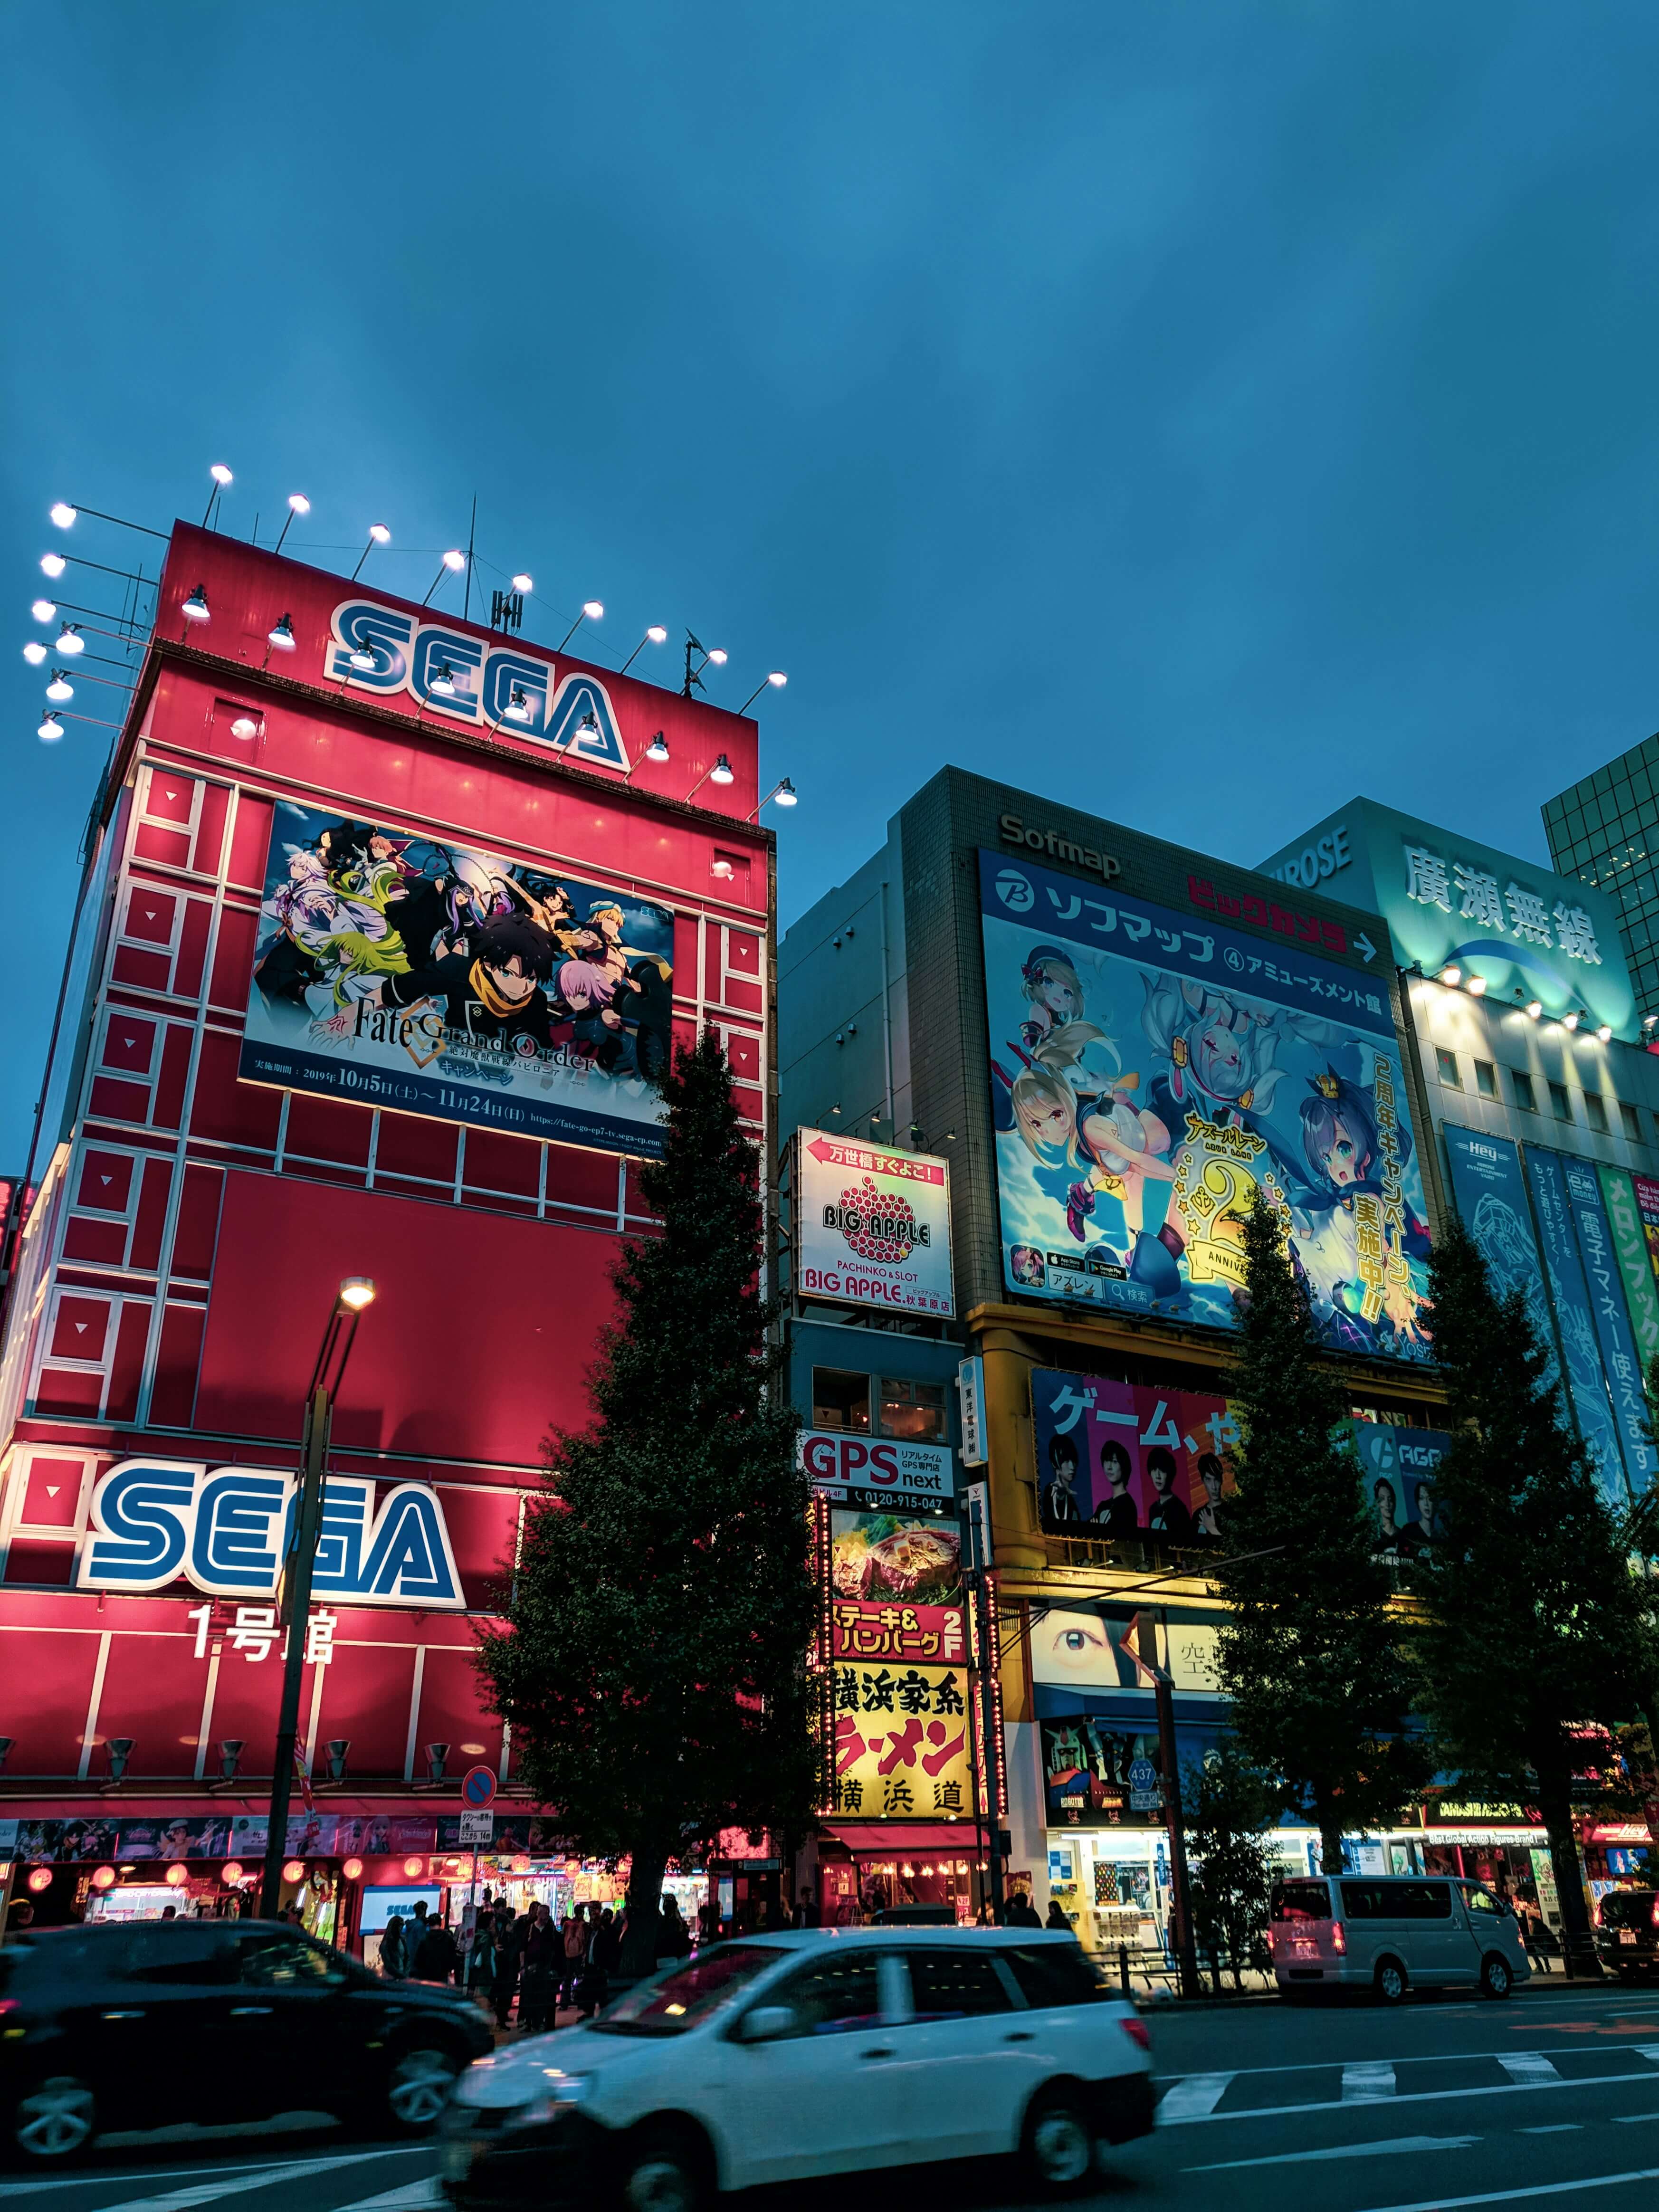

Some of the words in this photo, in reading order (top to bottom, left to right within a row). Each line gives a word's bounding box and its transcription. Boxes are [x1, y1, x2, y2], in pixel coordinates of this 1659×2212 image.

[324, 600, 631, 773] SEGA
[1001, 814, 1121, 880] Sofmap
[1046, 887, 1215, 962] ソフマップ
[1187, 875, 1347, 953] ビックカメラ
[352, 996, 413, 1048] Fate
[415, 1013, 511, 1051] Grand
[510, 1031, 596, 1072] Order
[440, 1059, 514, 1086] キャンペーン
[448, 1045, 560, 1077] 絶対魔獣戦線バビロニア
[1186, 1112, 1265, 1152] アズールレーン
[1205, 1143, 1227, 1154] AZUR
[1230, 1149, 1252, 1160] LANE
[1469, 1141, 1497, 1162] Hey
[1467, 1164, 1507, 1179] ENTERTAINMENT
[1573, 1188, 1597, 1204] money
[823, 1203, 862, 1232] BIG
[869, 1214, 931, 1247] APPLE
[1643, 1212, 1659, 1224] 日本
[837, 1260, 887, 1278] PACHINKO
[895, 1270, 918, 1283] SLOT
[1099, 1265, 1113, 1273] Google
[1609, 1178, 1659, 1358] メロンブック
[805, 1268, 841, 1292] BIG
[1052, 1273, 1095, 1290] アズレン
[906, 1295, 950, 1312] 秋葉原店
[1127, 1288, 1148, 1304] 検索
[1581, 1211, 1650, 1471] 電子マネー使えます
[803, 1436, 898, 1486] GPS
[902, 1450, 942, 1463] リアルタイム
[902, 1460, 940, 1472] GPS専門店
[903, 1474, 942, 1490] next
[865, 1491, 943, 1509] 0120-915-047
[76, 1459, 467, 1609] SEGA
[841, 1629, 939, 1655] ハンバーグ
[835, 1668, 965, 1716] 横浜家系
[835, 1714, 965, 1777] ラーメン
[1132, 1768, 1152, 1781] 437
[836, 1779, 964, 1813] 横浜道
[461, 1832, 477, 1840] ここから
[480, 1831, 491, 1840] 14m
[1429, 1834, 1445, 1844] Best
[1446, 1834, 1467, 1844] Global
[1468, 1834, 1489, 1844] Action
[1490, 1835, 1513, 1845] Figures
[1515, 1835, 1535, 1844] Brand
[1618, 1823, 1649, 1838] Hey
[386, 1904, 416, 1916] SEGA
